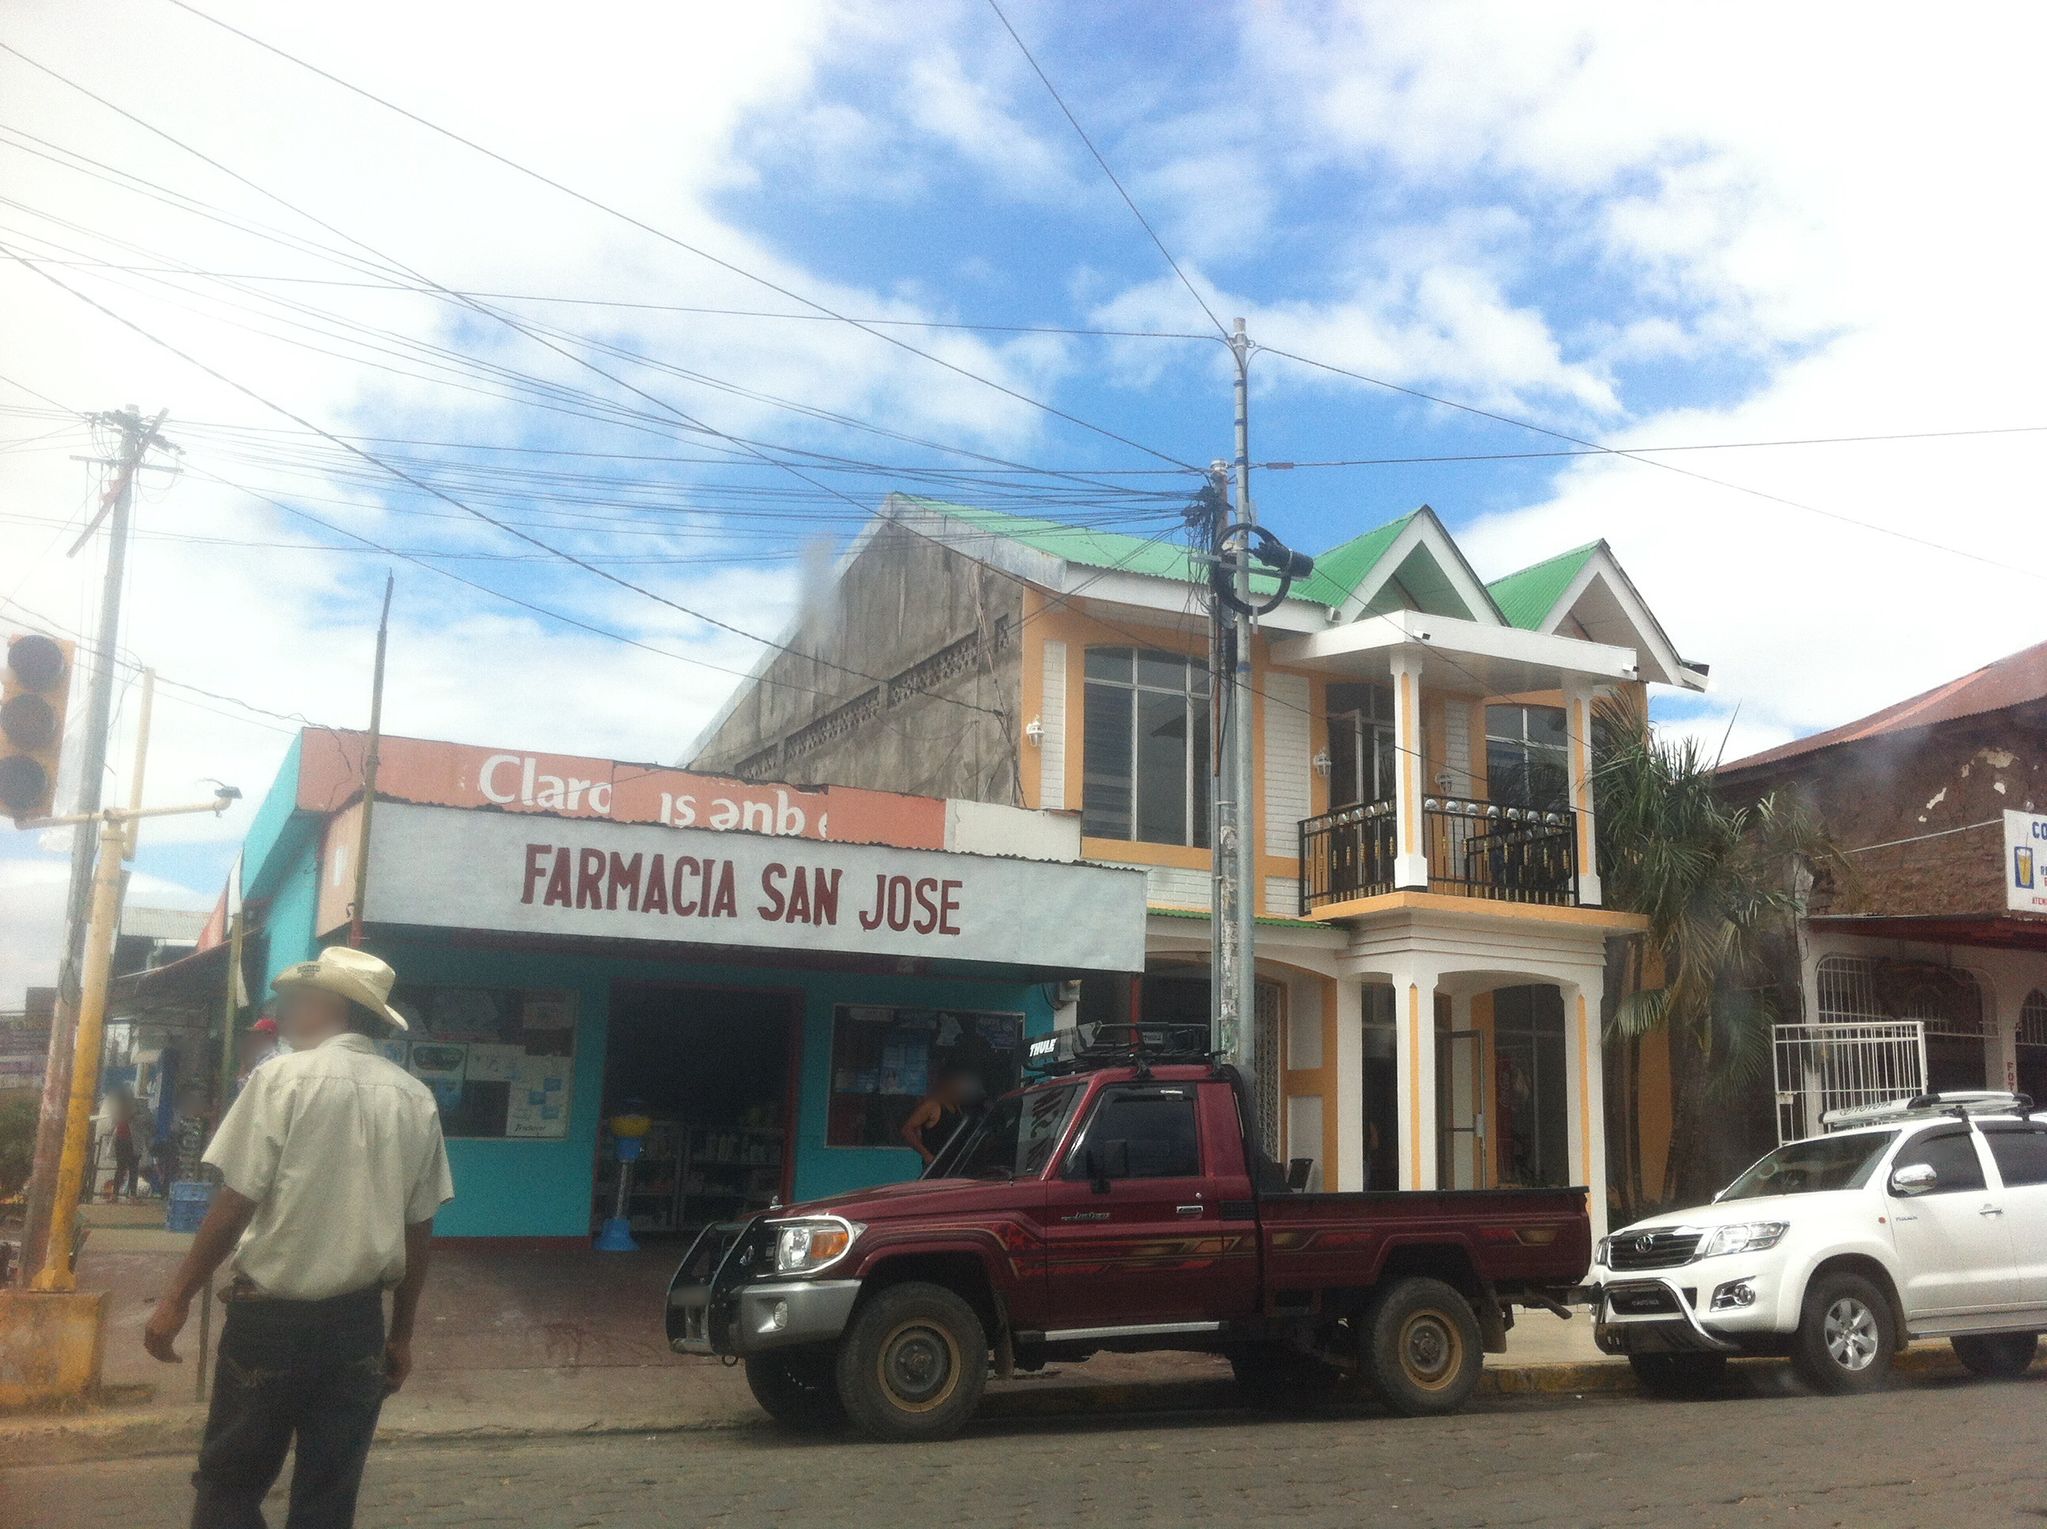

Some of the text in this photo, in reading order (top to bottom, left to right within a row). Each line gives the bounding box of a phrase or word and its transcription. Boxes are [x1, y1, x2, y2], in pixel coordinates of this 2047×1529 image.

[520, 843, 963, 936] FARMACIA SAN JOSE
[1029, 1037, 1057, 1057] THULE
